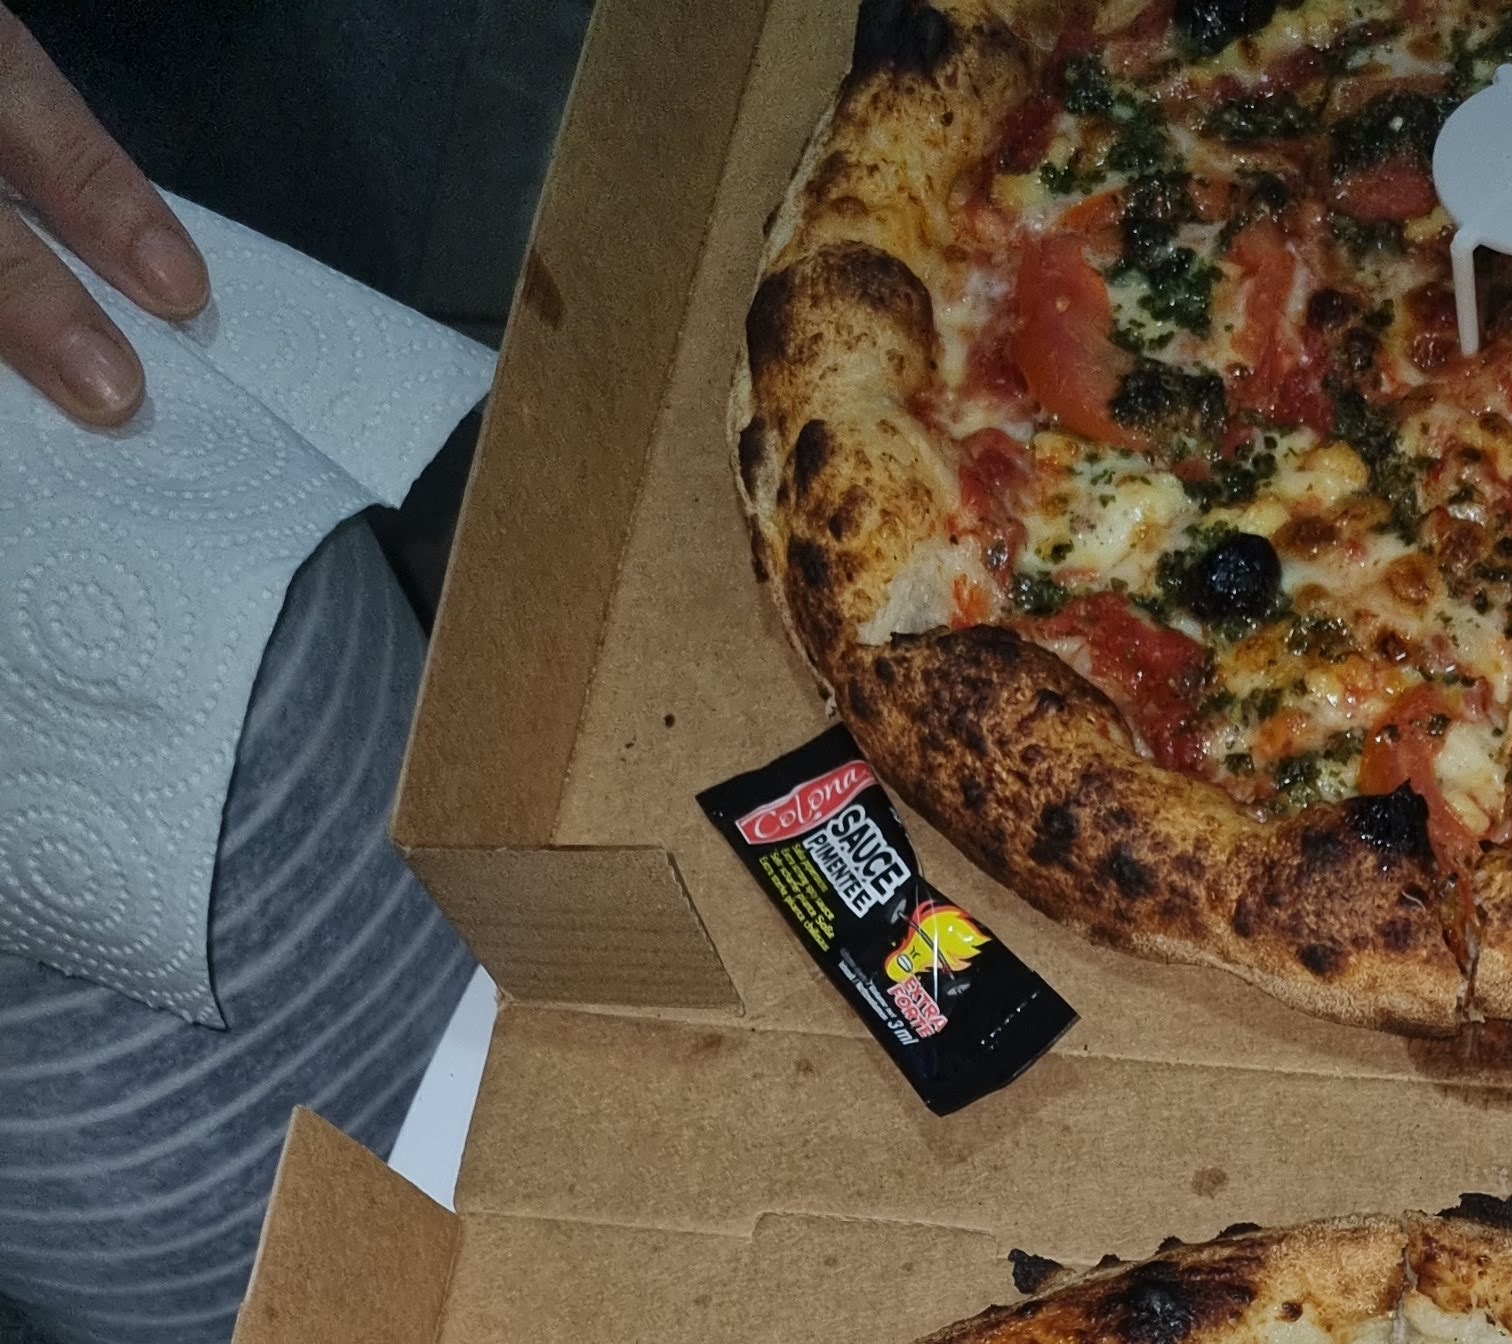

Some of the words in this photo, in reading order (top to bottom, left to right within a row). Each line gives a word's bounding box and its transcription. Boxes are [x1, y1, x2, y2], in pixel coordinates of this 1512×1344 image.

[754, 767, 869, 839] Colona
[806, 832, 873, 913] PIMENTÉE
[829, 807, 907, 898] SAUCE
[887, 983, 935, 1038] FORTE
[887, 1020, 904, 1029] 3
[904, 975, 948, 1032] EXTRA
[894, 1028, 919, 1046] ml
